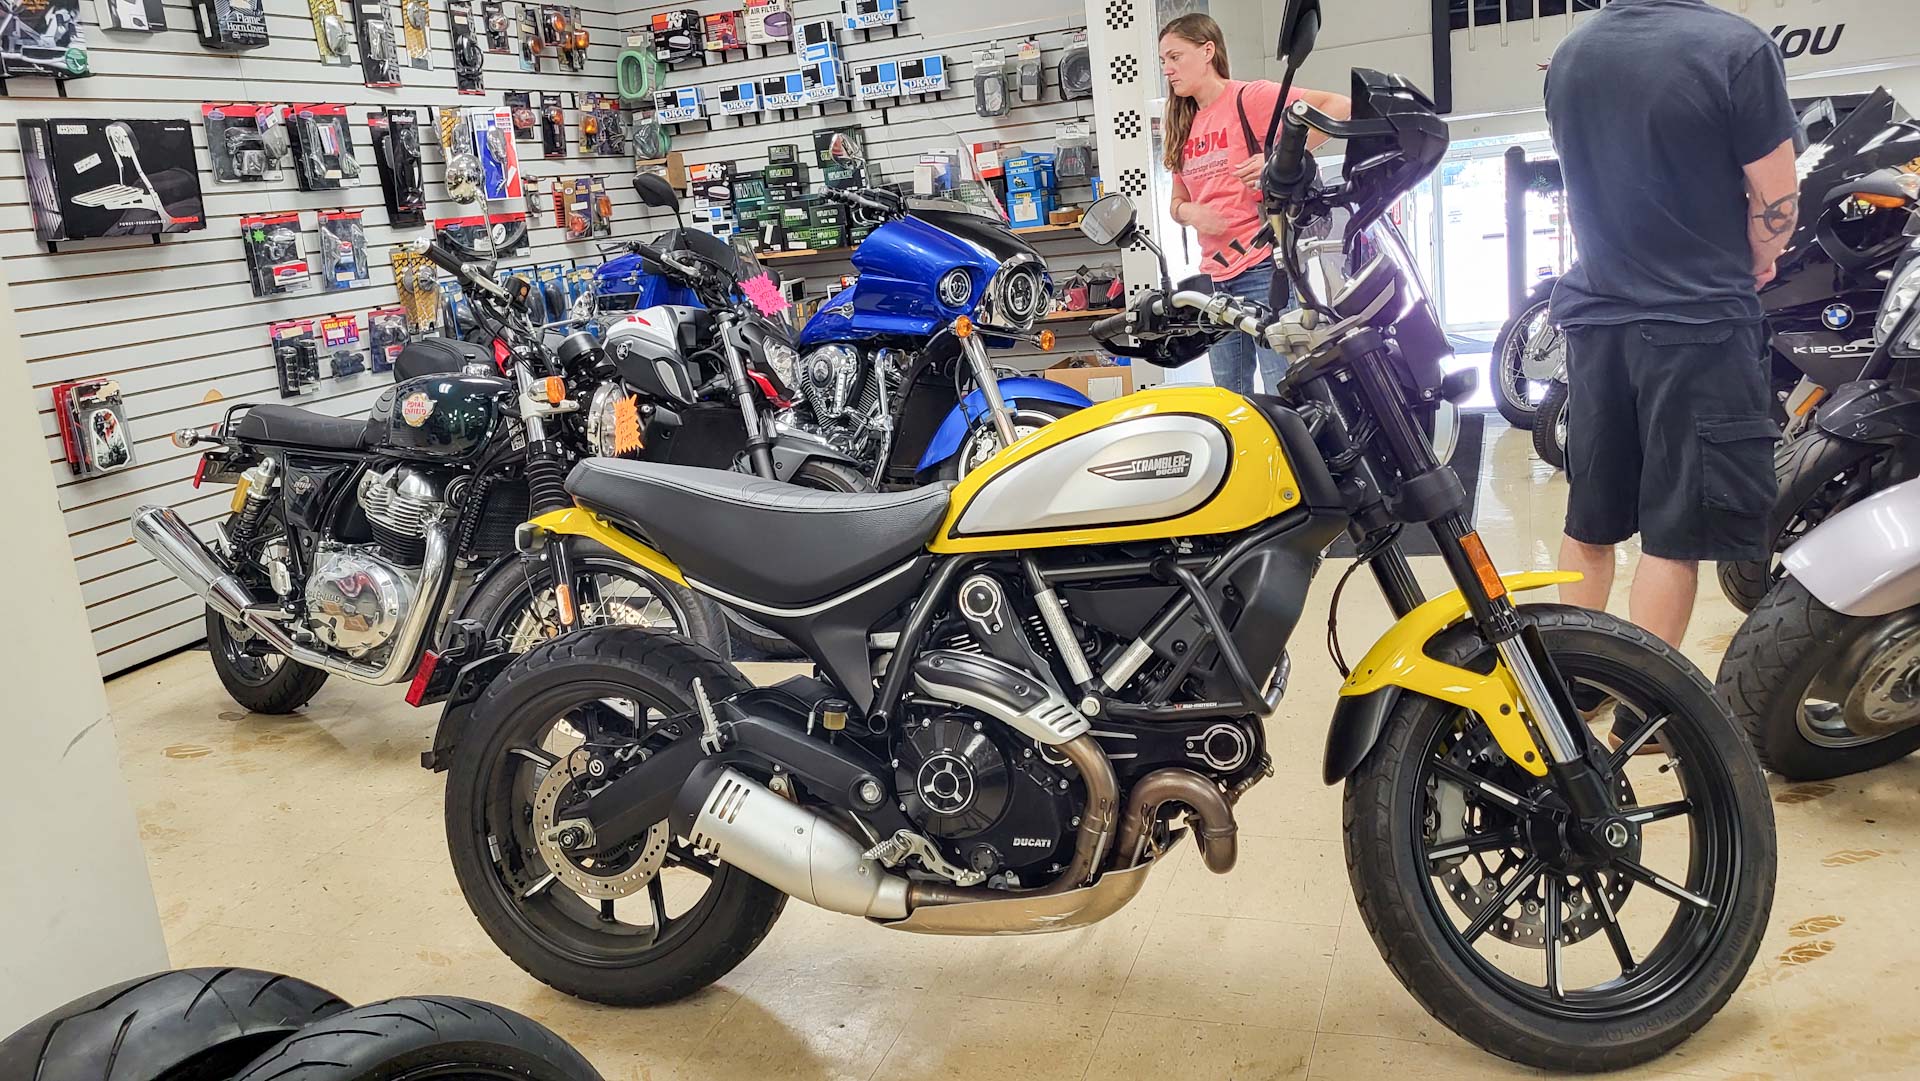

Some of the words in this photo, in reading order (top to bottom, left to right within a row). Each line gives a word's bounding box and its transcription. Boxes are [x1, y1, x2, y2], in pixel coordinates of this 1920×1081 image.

[762, 4, 780, 14] FILTER
[236, 12, 260, 24] Flame
[864, 11, 890, 23] DRAG
[227, 22, 246, 32] Horn
[246, 23, 265, 33] Cover
[1770, 24, 1845, 58] OU
[909, 77, 938, 89] DRAG
[810, 88, 833, 98] DRAG
[864, 83, 892, 95] DRAG
[771, 94, 799, 104] DRAG
[726, 101, 750, 110] DRAG
[664, 108, 692, 119] DRAG
[1183, 128, 1228, 160] RUN
[1131, 454, 1186, 473] SCRAMBLER
[1155, 467, 1184, 476] DUCATI
[1012, 838, 1052, 848] DUCATI
